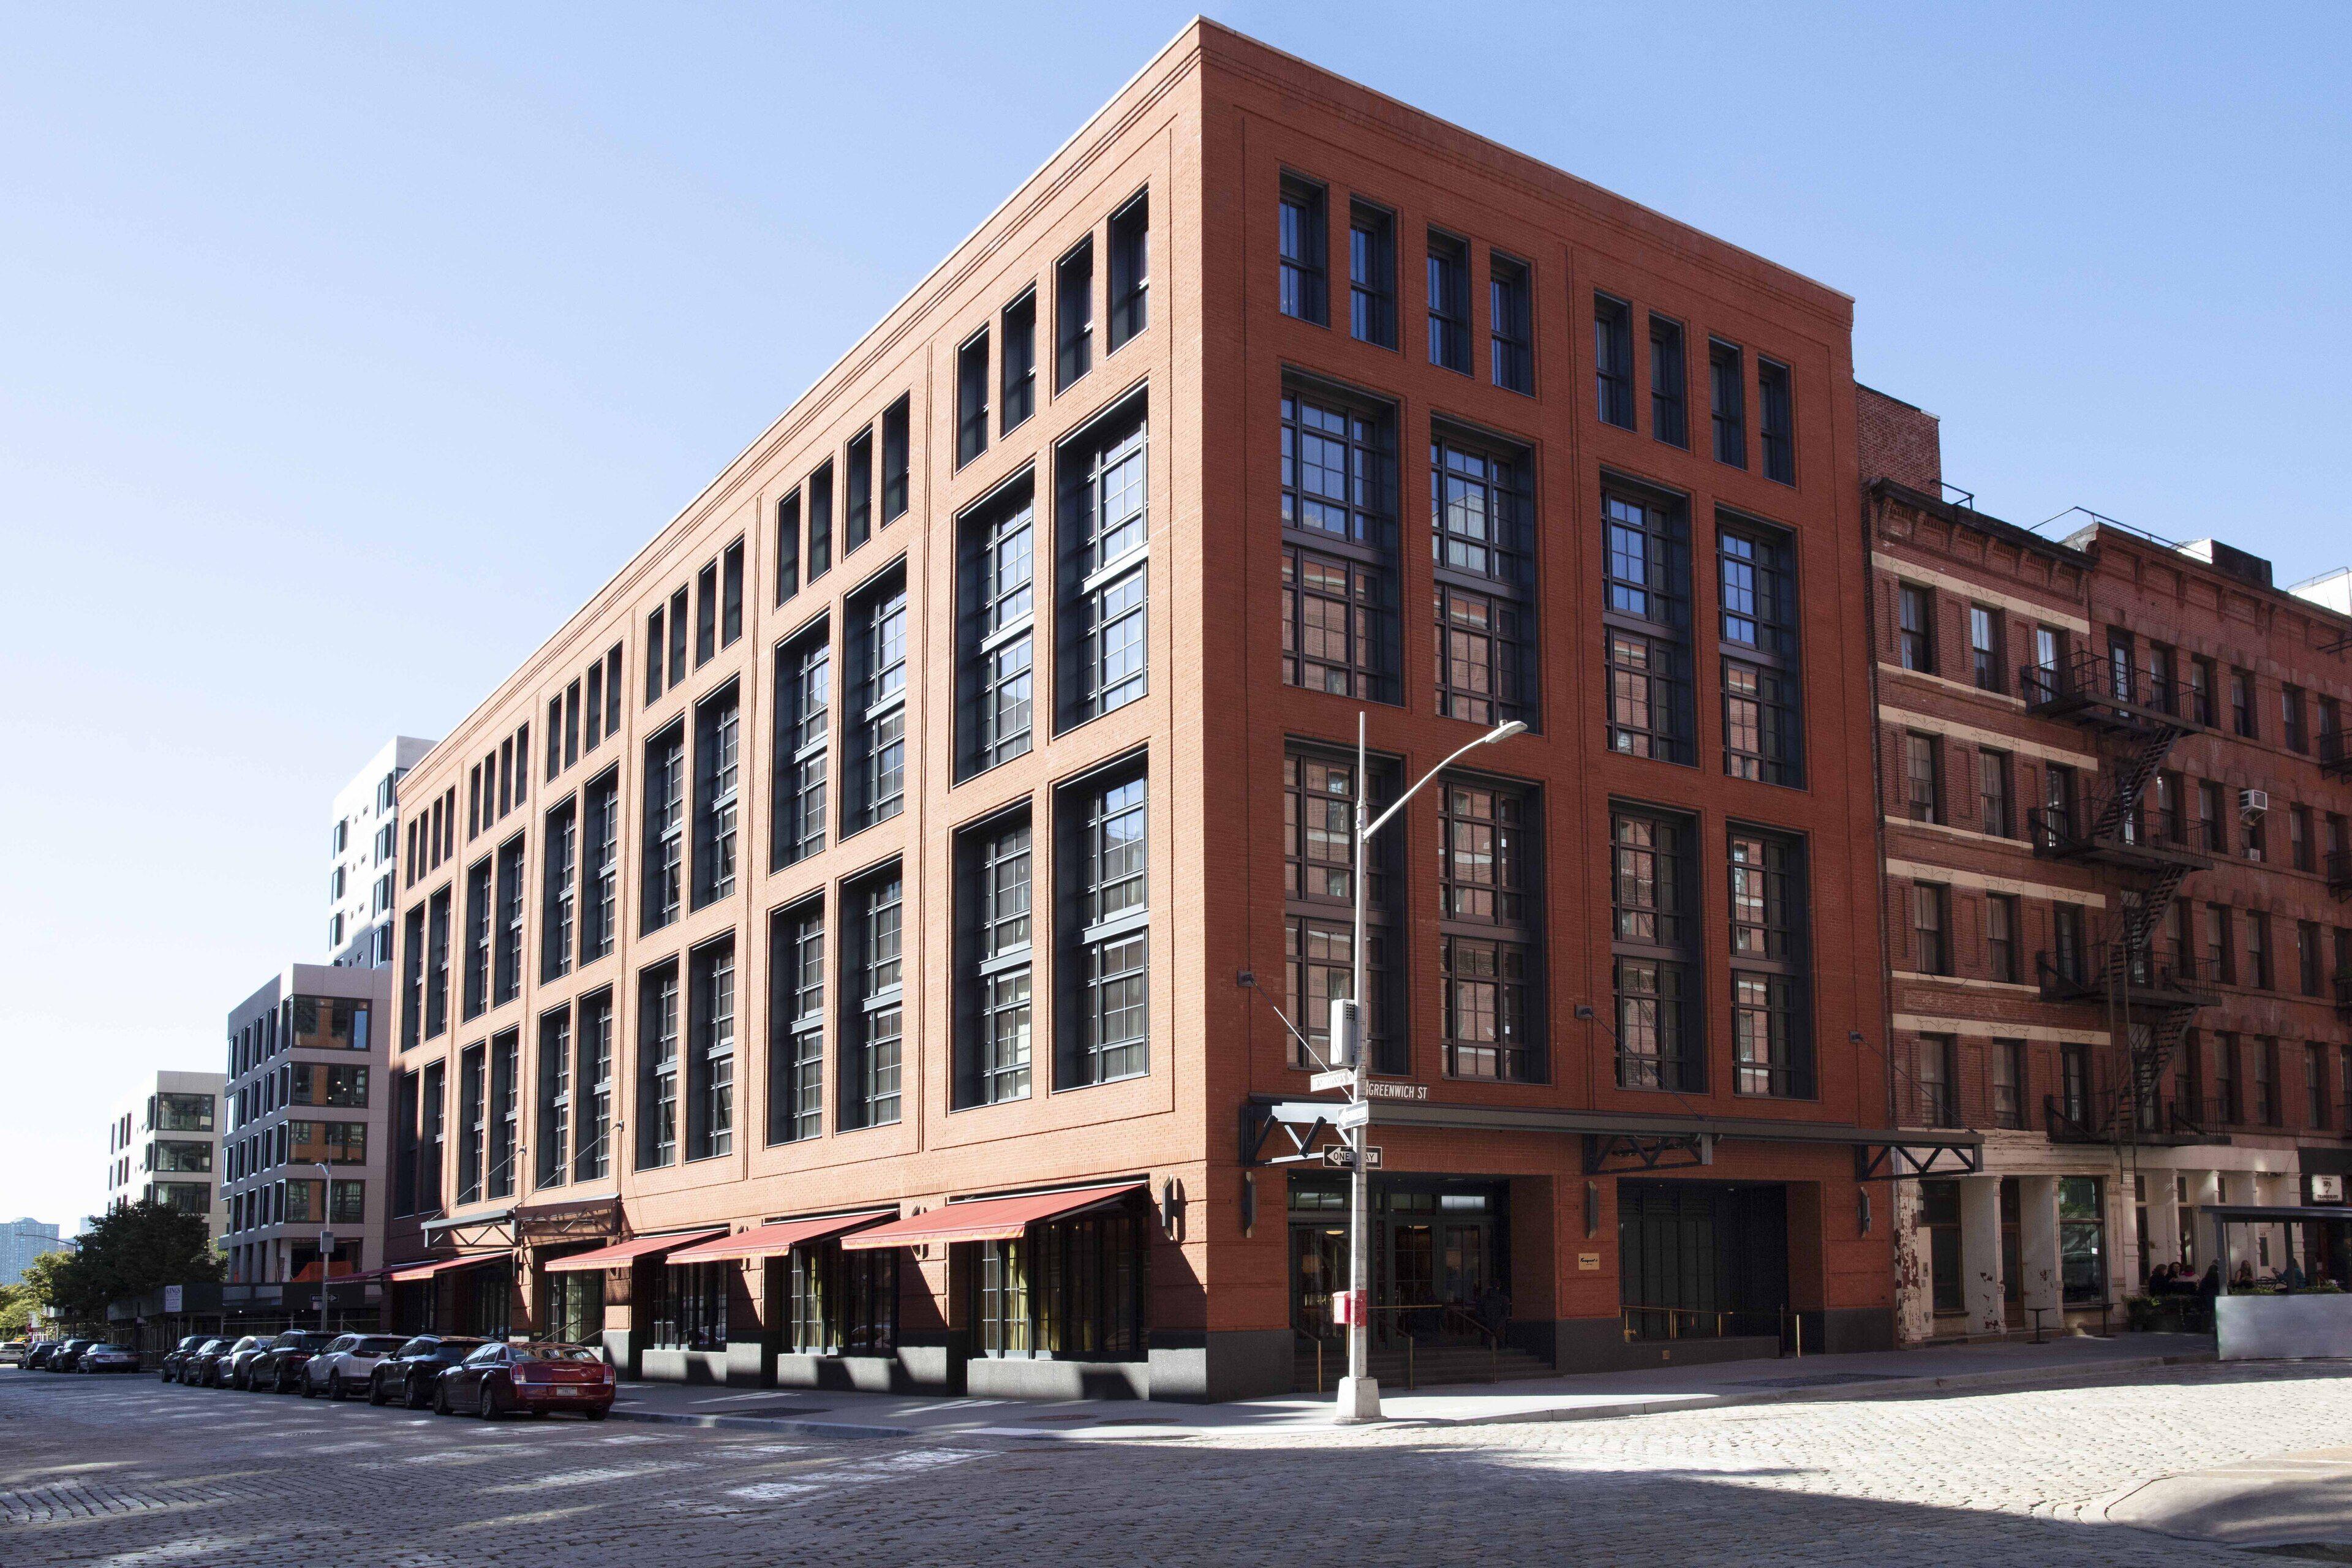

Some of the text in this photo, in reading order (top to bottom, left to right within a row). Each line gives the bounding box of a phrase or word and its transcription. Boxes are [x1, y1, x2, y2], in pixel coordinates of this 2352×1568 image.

[1368, 1082, 1428, 1099] GREENWICH ST
[1333, 1152, 1350, 1161] ONE
